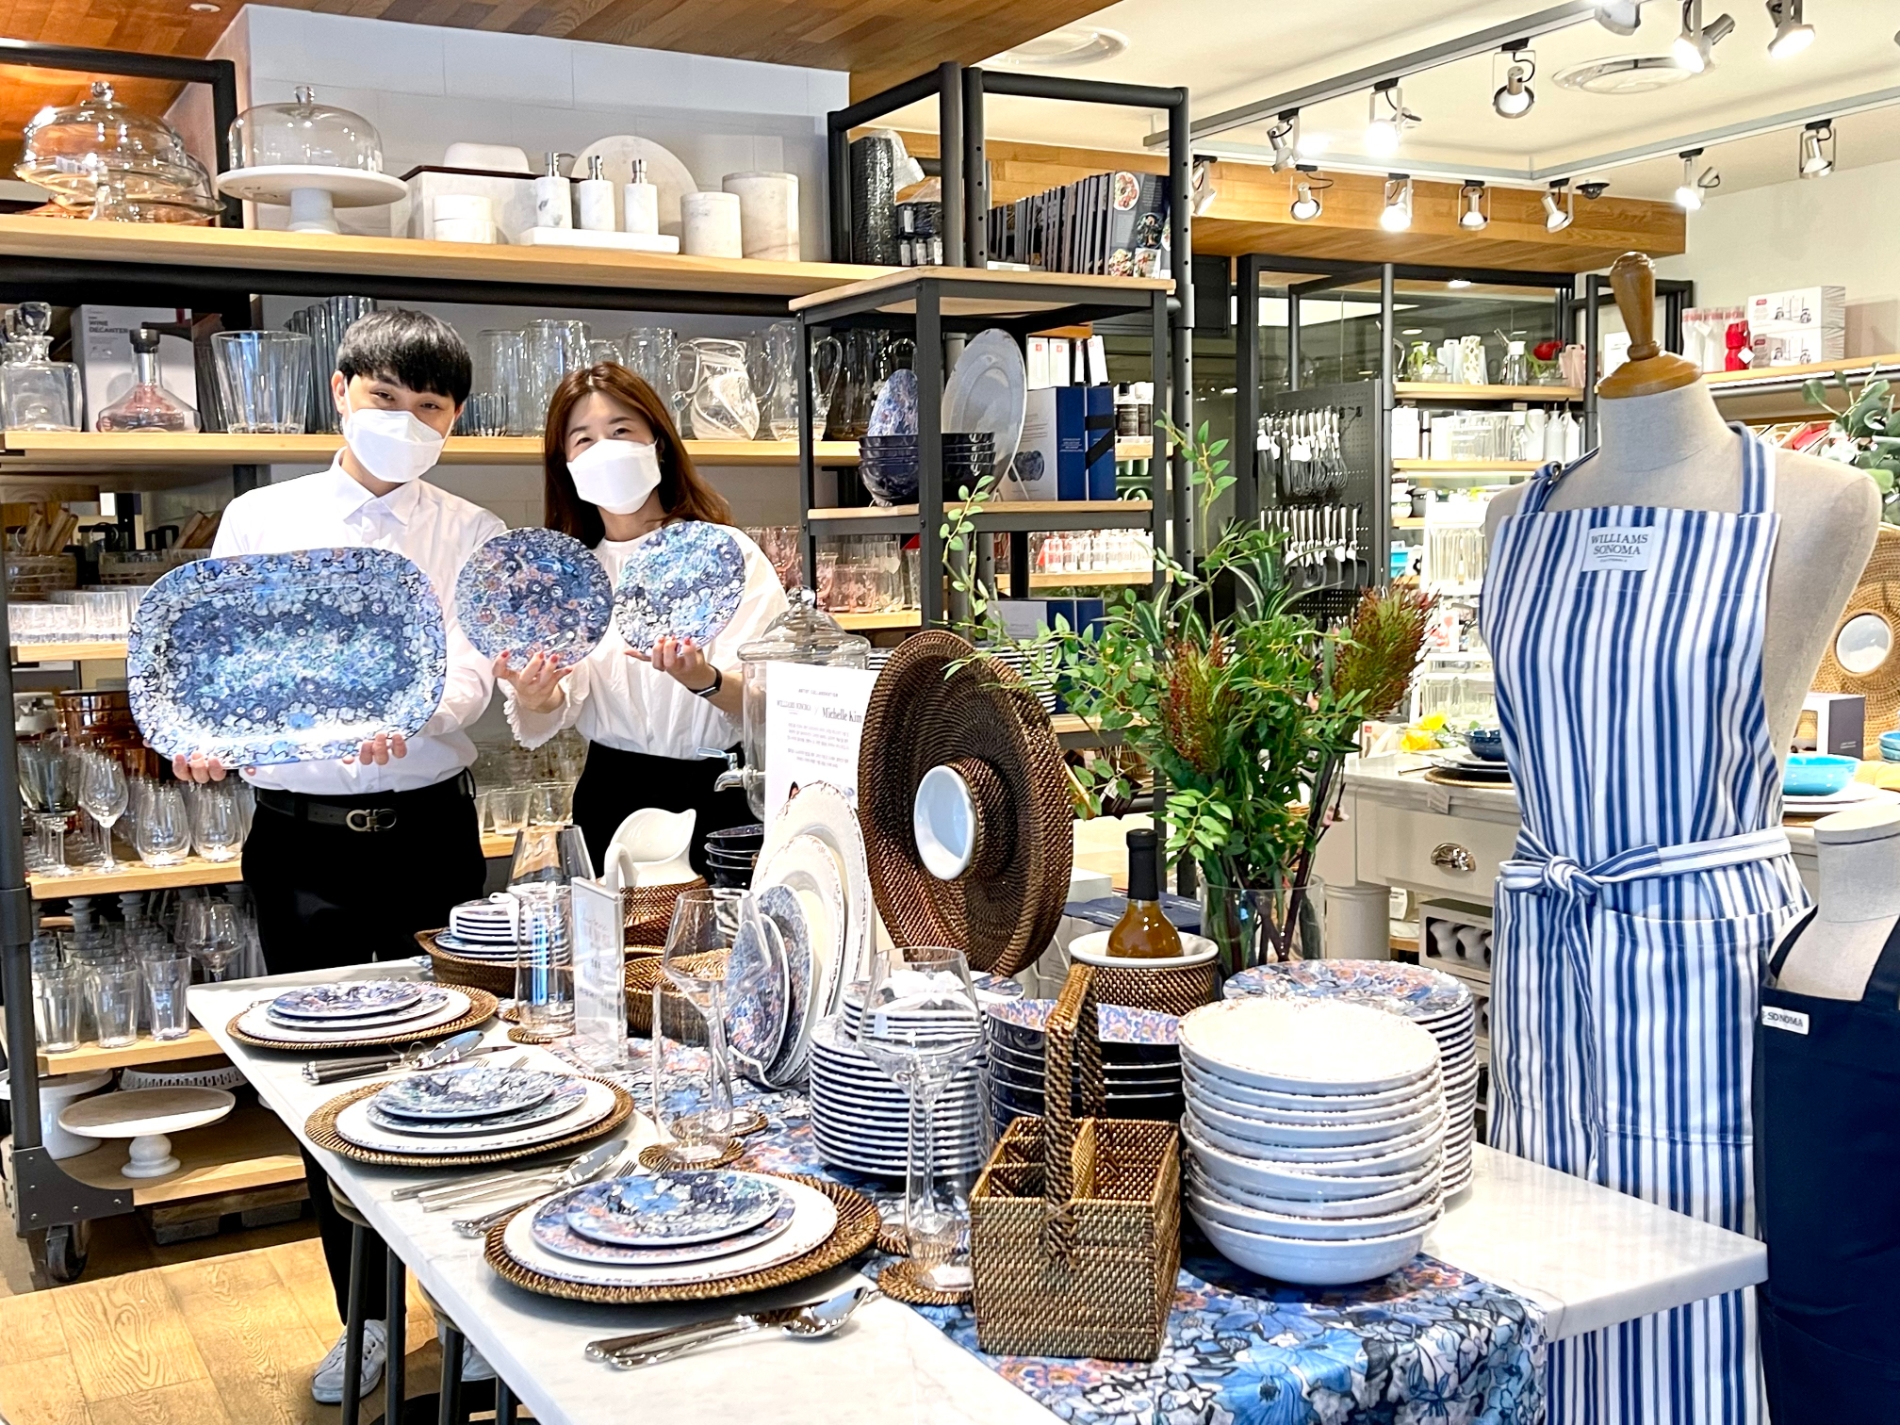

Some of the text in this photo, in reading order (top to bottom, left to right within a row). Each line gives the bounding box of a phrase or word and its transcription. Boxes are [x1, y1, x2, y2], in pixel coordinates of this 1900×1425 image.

[1591, 533, 1649, 544] WILLIAMS
[1593, 544, 1641, 555] SONOMA
[822, 707, 847, 721] Michelle
[849, 710, 862, 723] Kim
